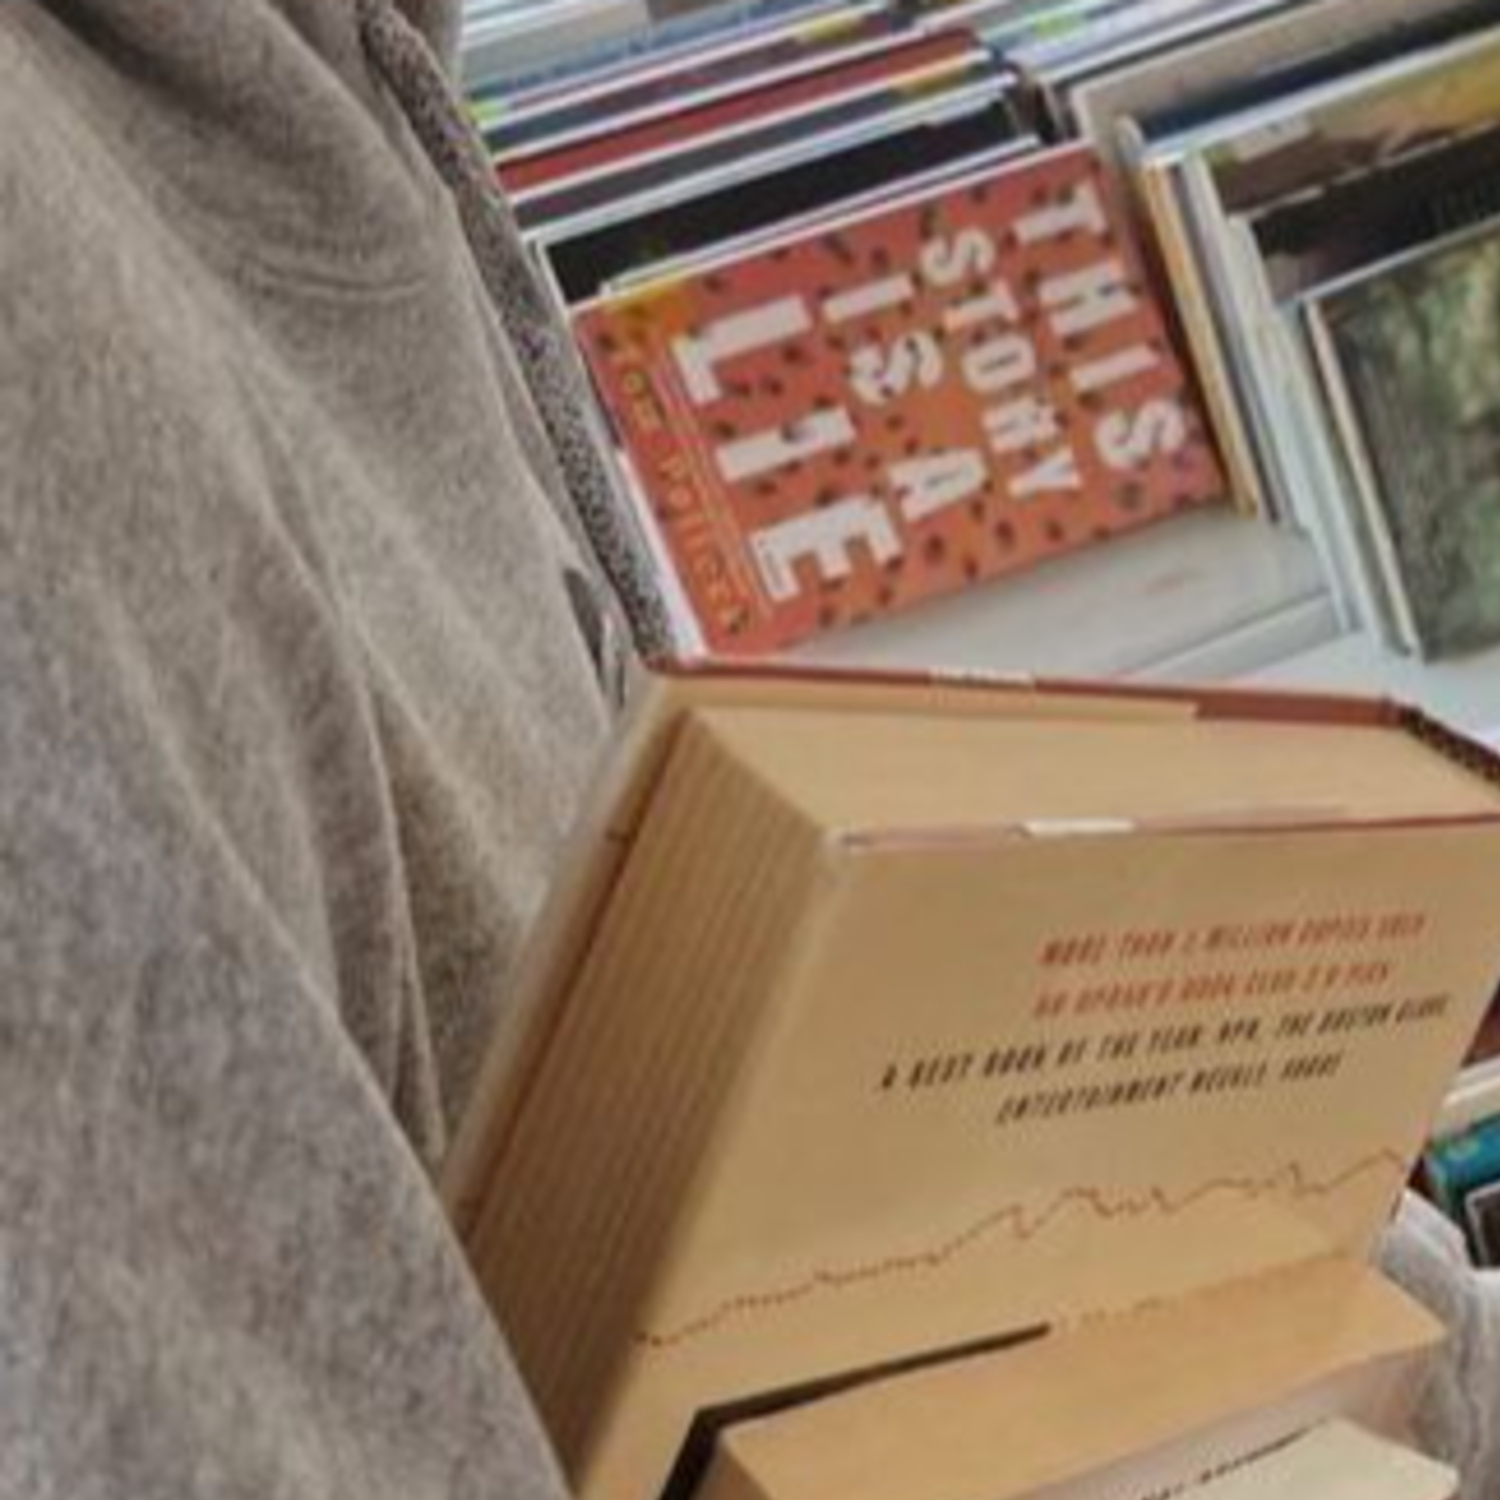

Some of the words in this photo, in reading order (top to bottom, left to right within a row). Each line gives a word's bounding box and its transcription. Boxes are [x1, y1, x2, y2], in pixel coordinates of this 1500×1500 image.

[672, 294, 899, 601] LIE
[822, 274, 943, 404] IS
[919, 228, 1081, 496] STORY
[1014, 181, 1186, 468] THIS
[888, 449, 987, 522] A
